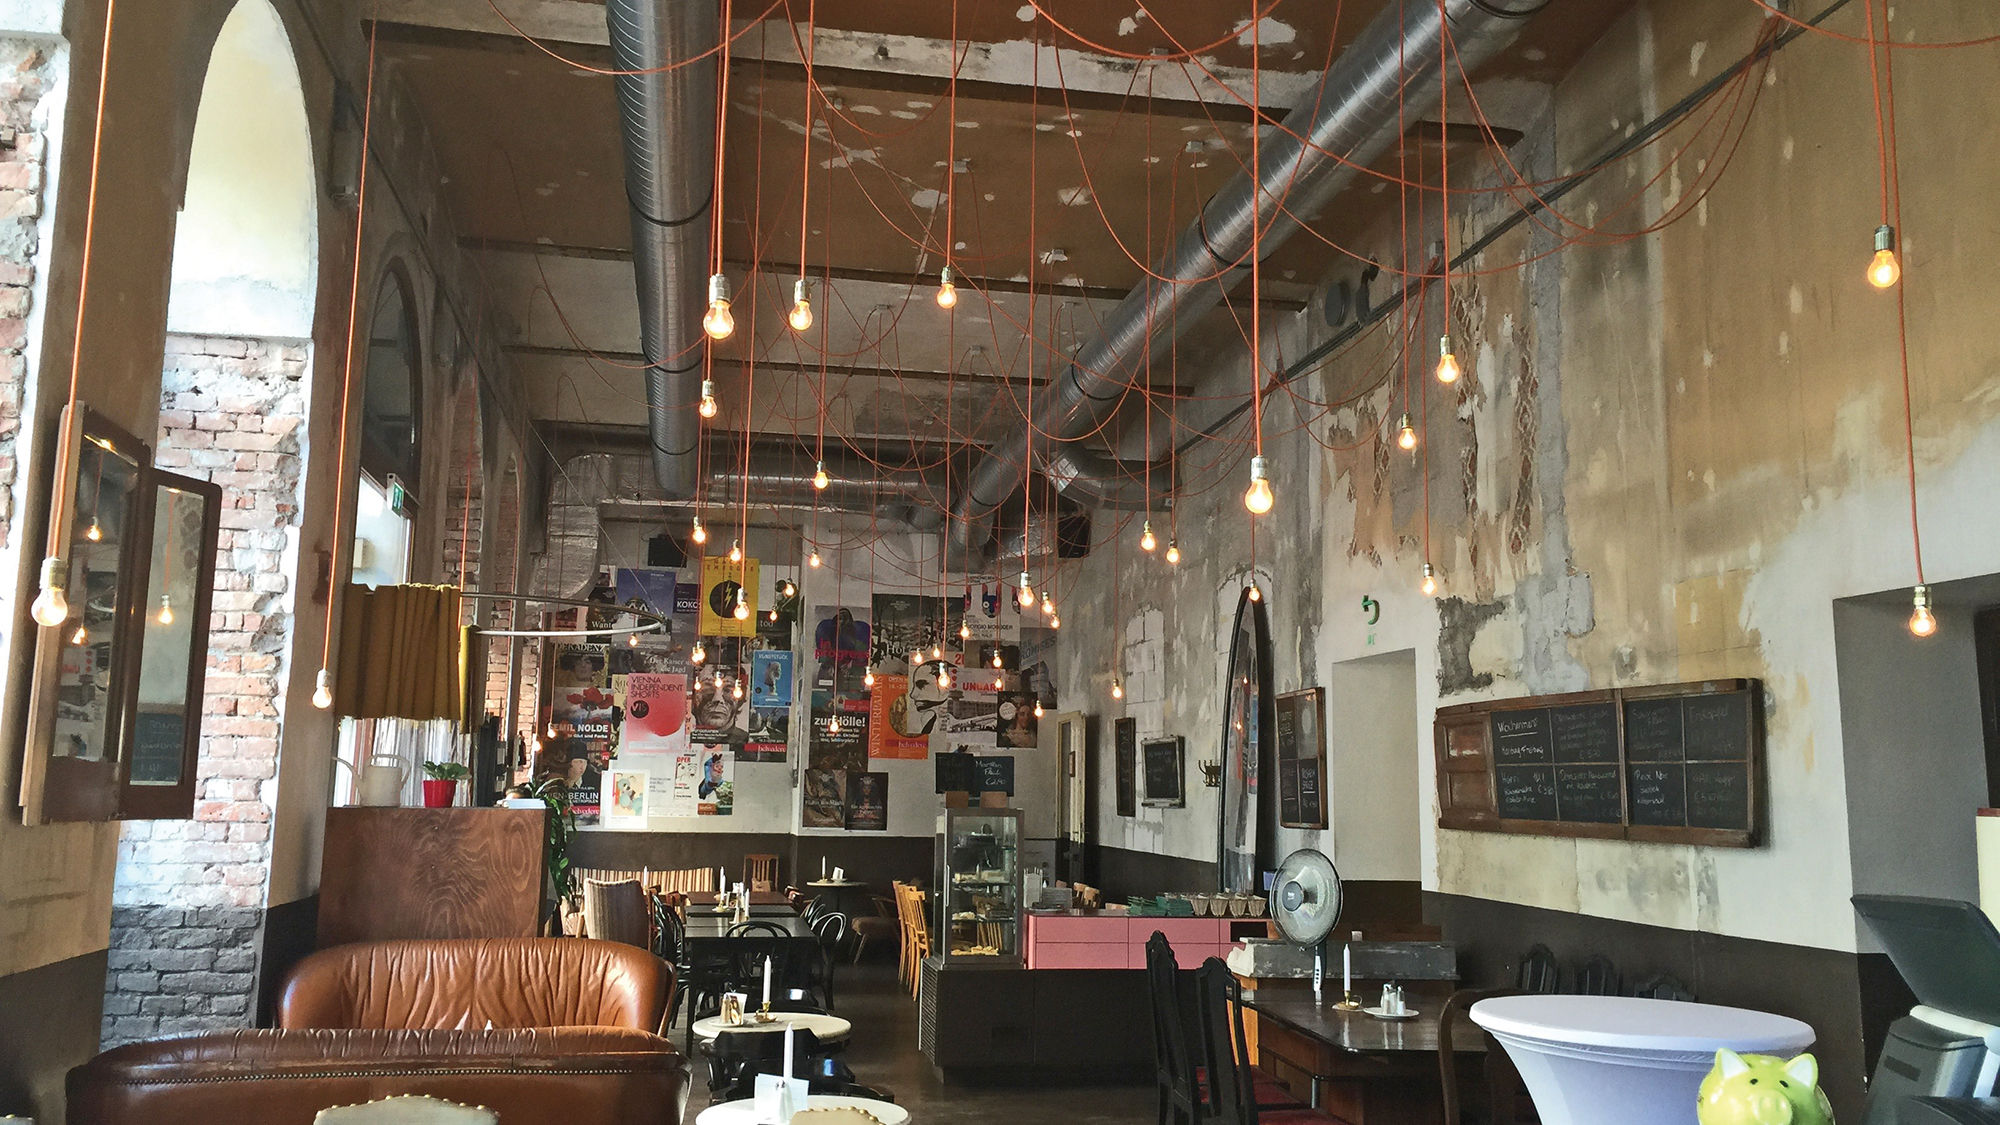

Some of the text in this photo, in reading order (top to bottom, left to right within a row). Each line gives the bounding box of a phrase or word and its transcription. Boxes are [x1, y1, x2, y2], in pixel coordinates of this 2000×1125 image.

[630, 683, 684, 692] INDEPENDENT
[630, 690, 660, 698] SHORTS
[577, 724, 609, 733] NOLDE
[568, 791, 599, 800] BERLIN
[573, 806, 600, 815] elvedere
